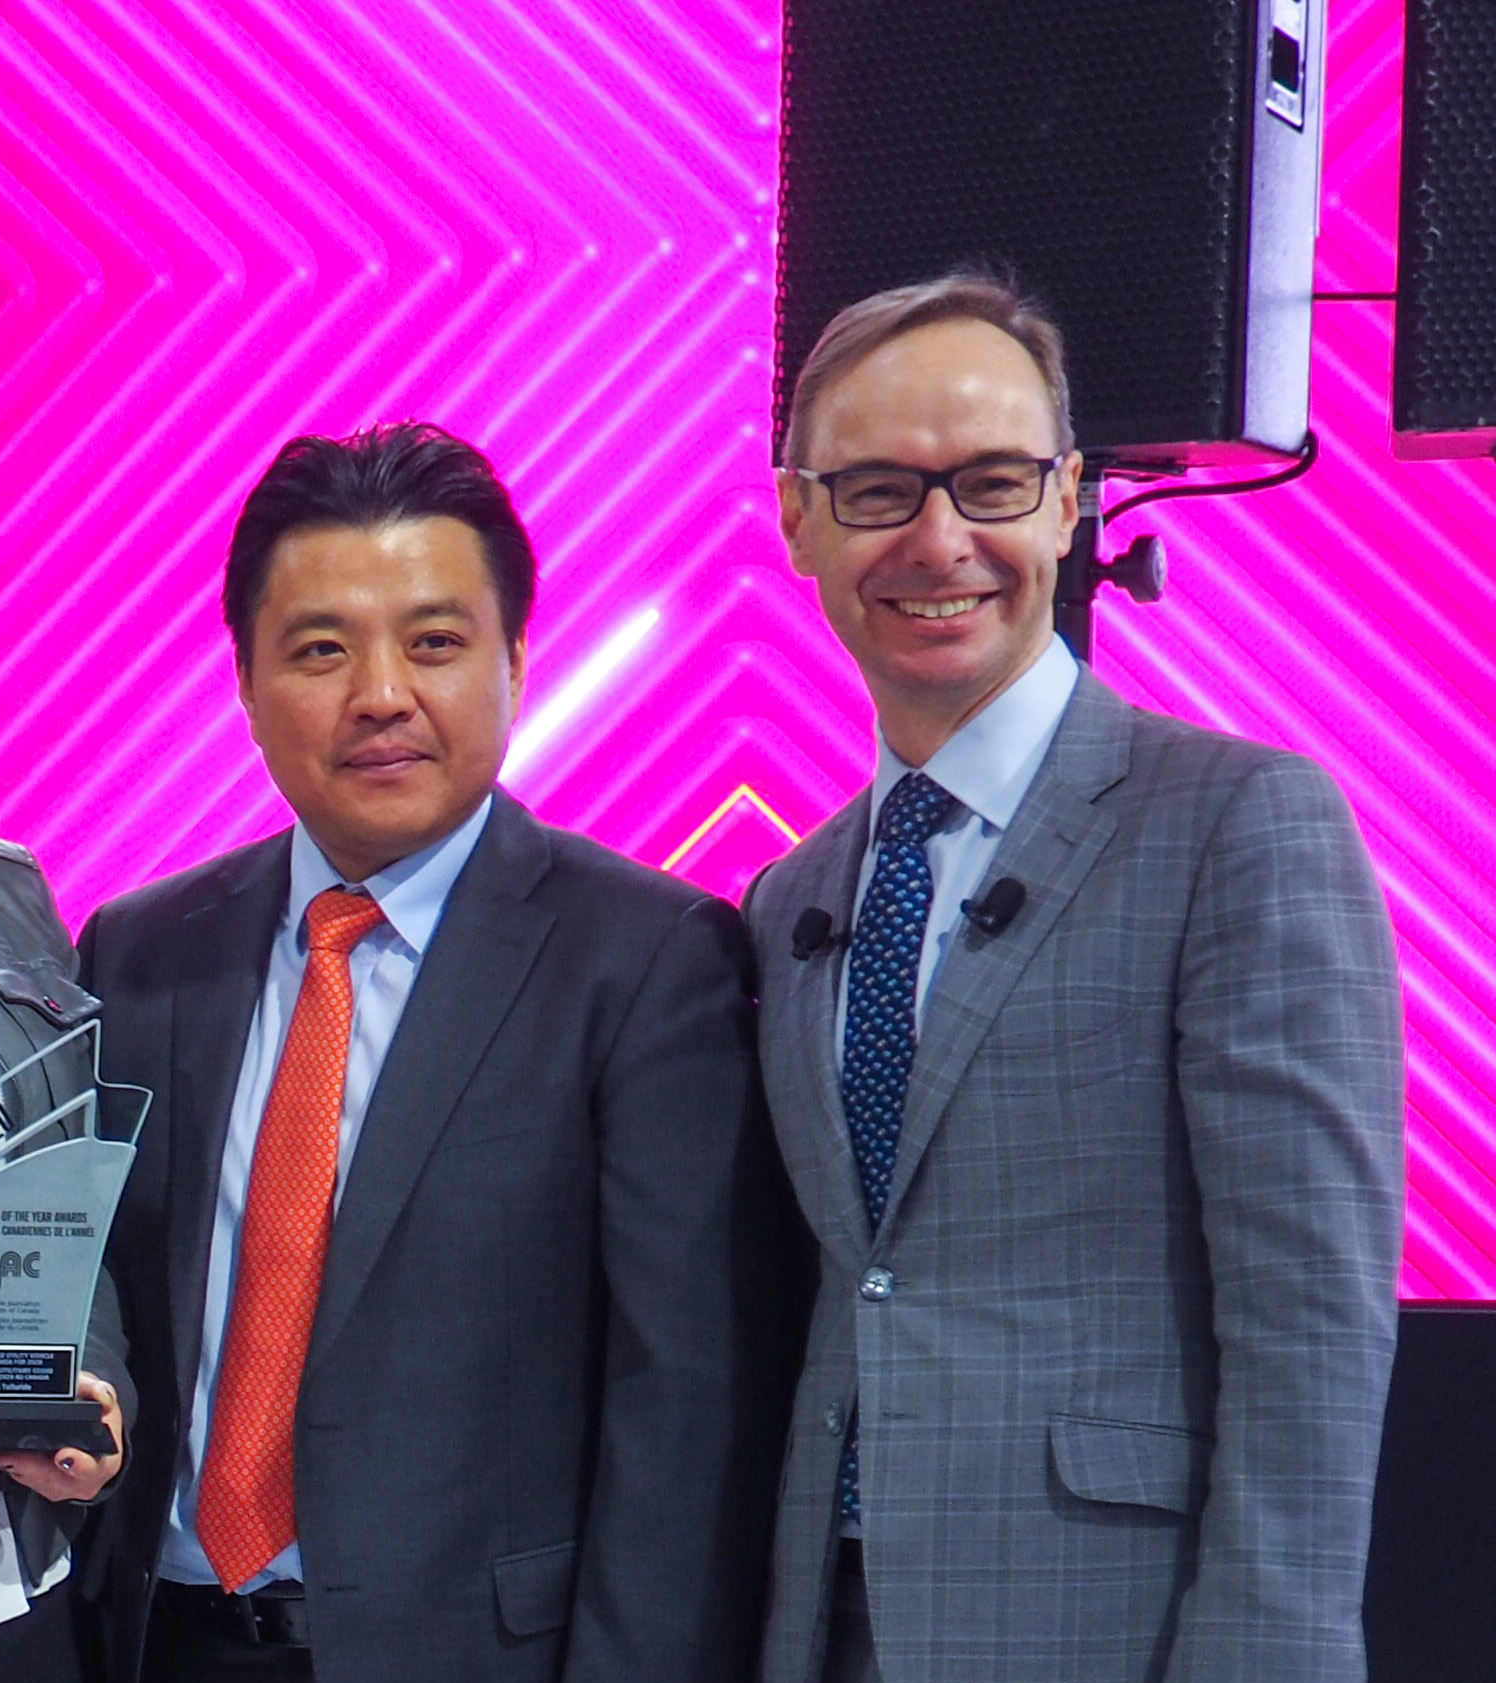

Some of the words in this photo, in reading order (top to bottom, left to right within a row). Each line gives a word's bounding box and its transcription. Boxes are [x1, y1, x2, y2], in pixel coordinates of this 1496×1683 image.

[1, 1211, 12, 1222] OF
[15, 1211, 29, 1222] THE
[32, 1211, 52, 1223] YEAR
[54, 1211, 87, 1223] AWARDS
